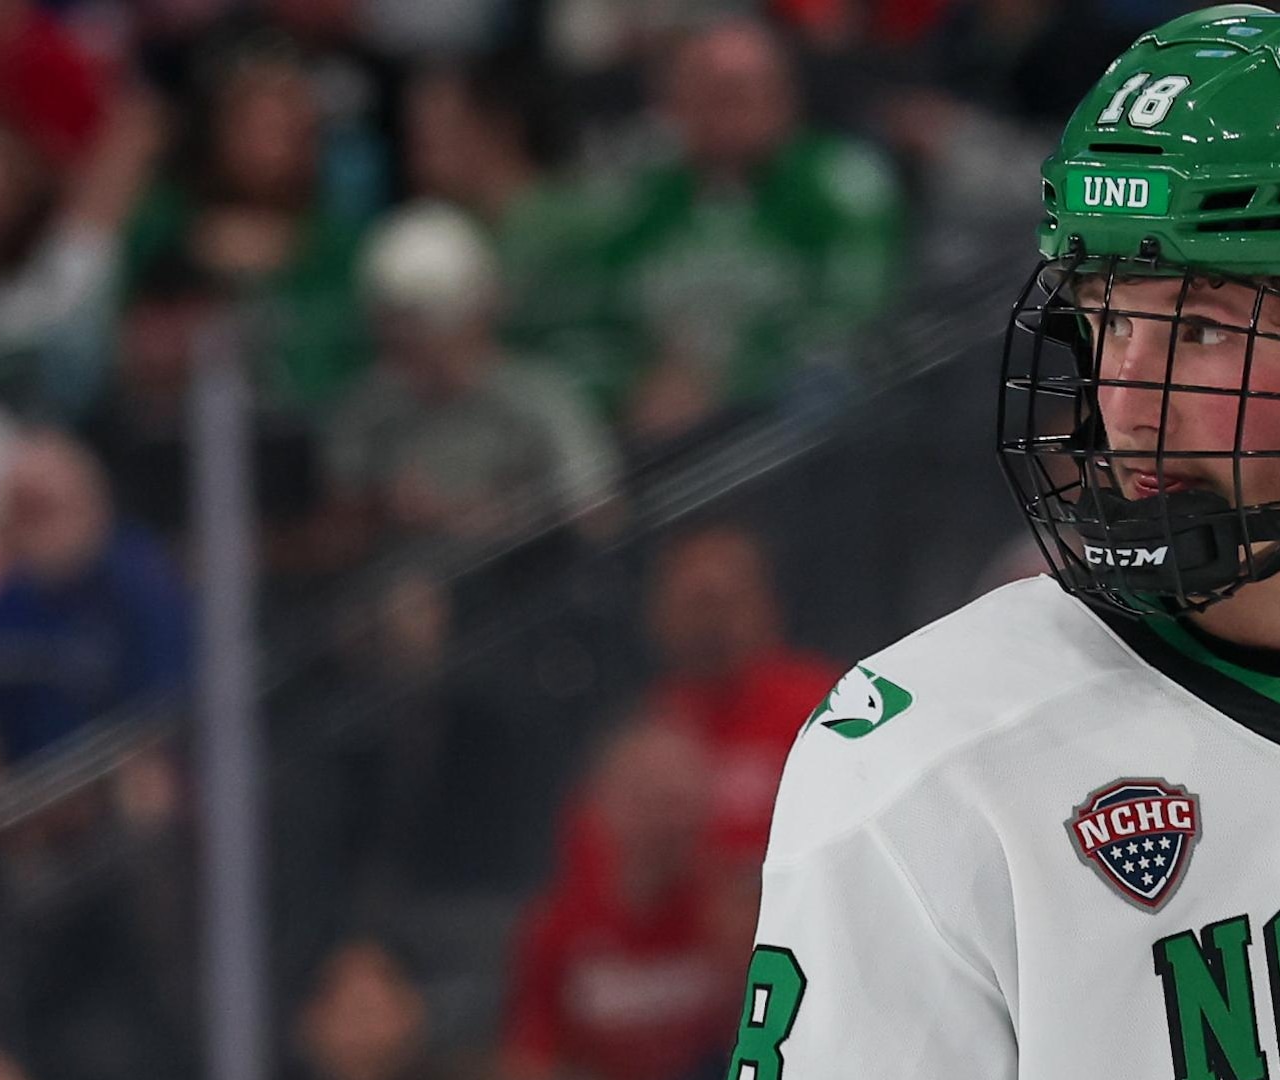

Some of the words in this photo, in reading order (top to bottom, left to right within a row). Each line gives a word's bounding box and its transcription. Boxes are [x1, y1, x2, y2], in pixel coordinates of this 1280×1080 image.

[1097, 72, 1191, 128] 18
[1084, 176, 1149, 208] UND
[1083, 544, 1169, 567] CCM
[1076, 800, 1193, 850] NCHC
